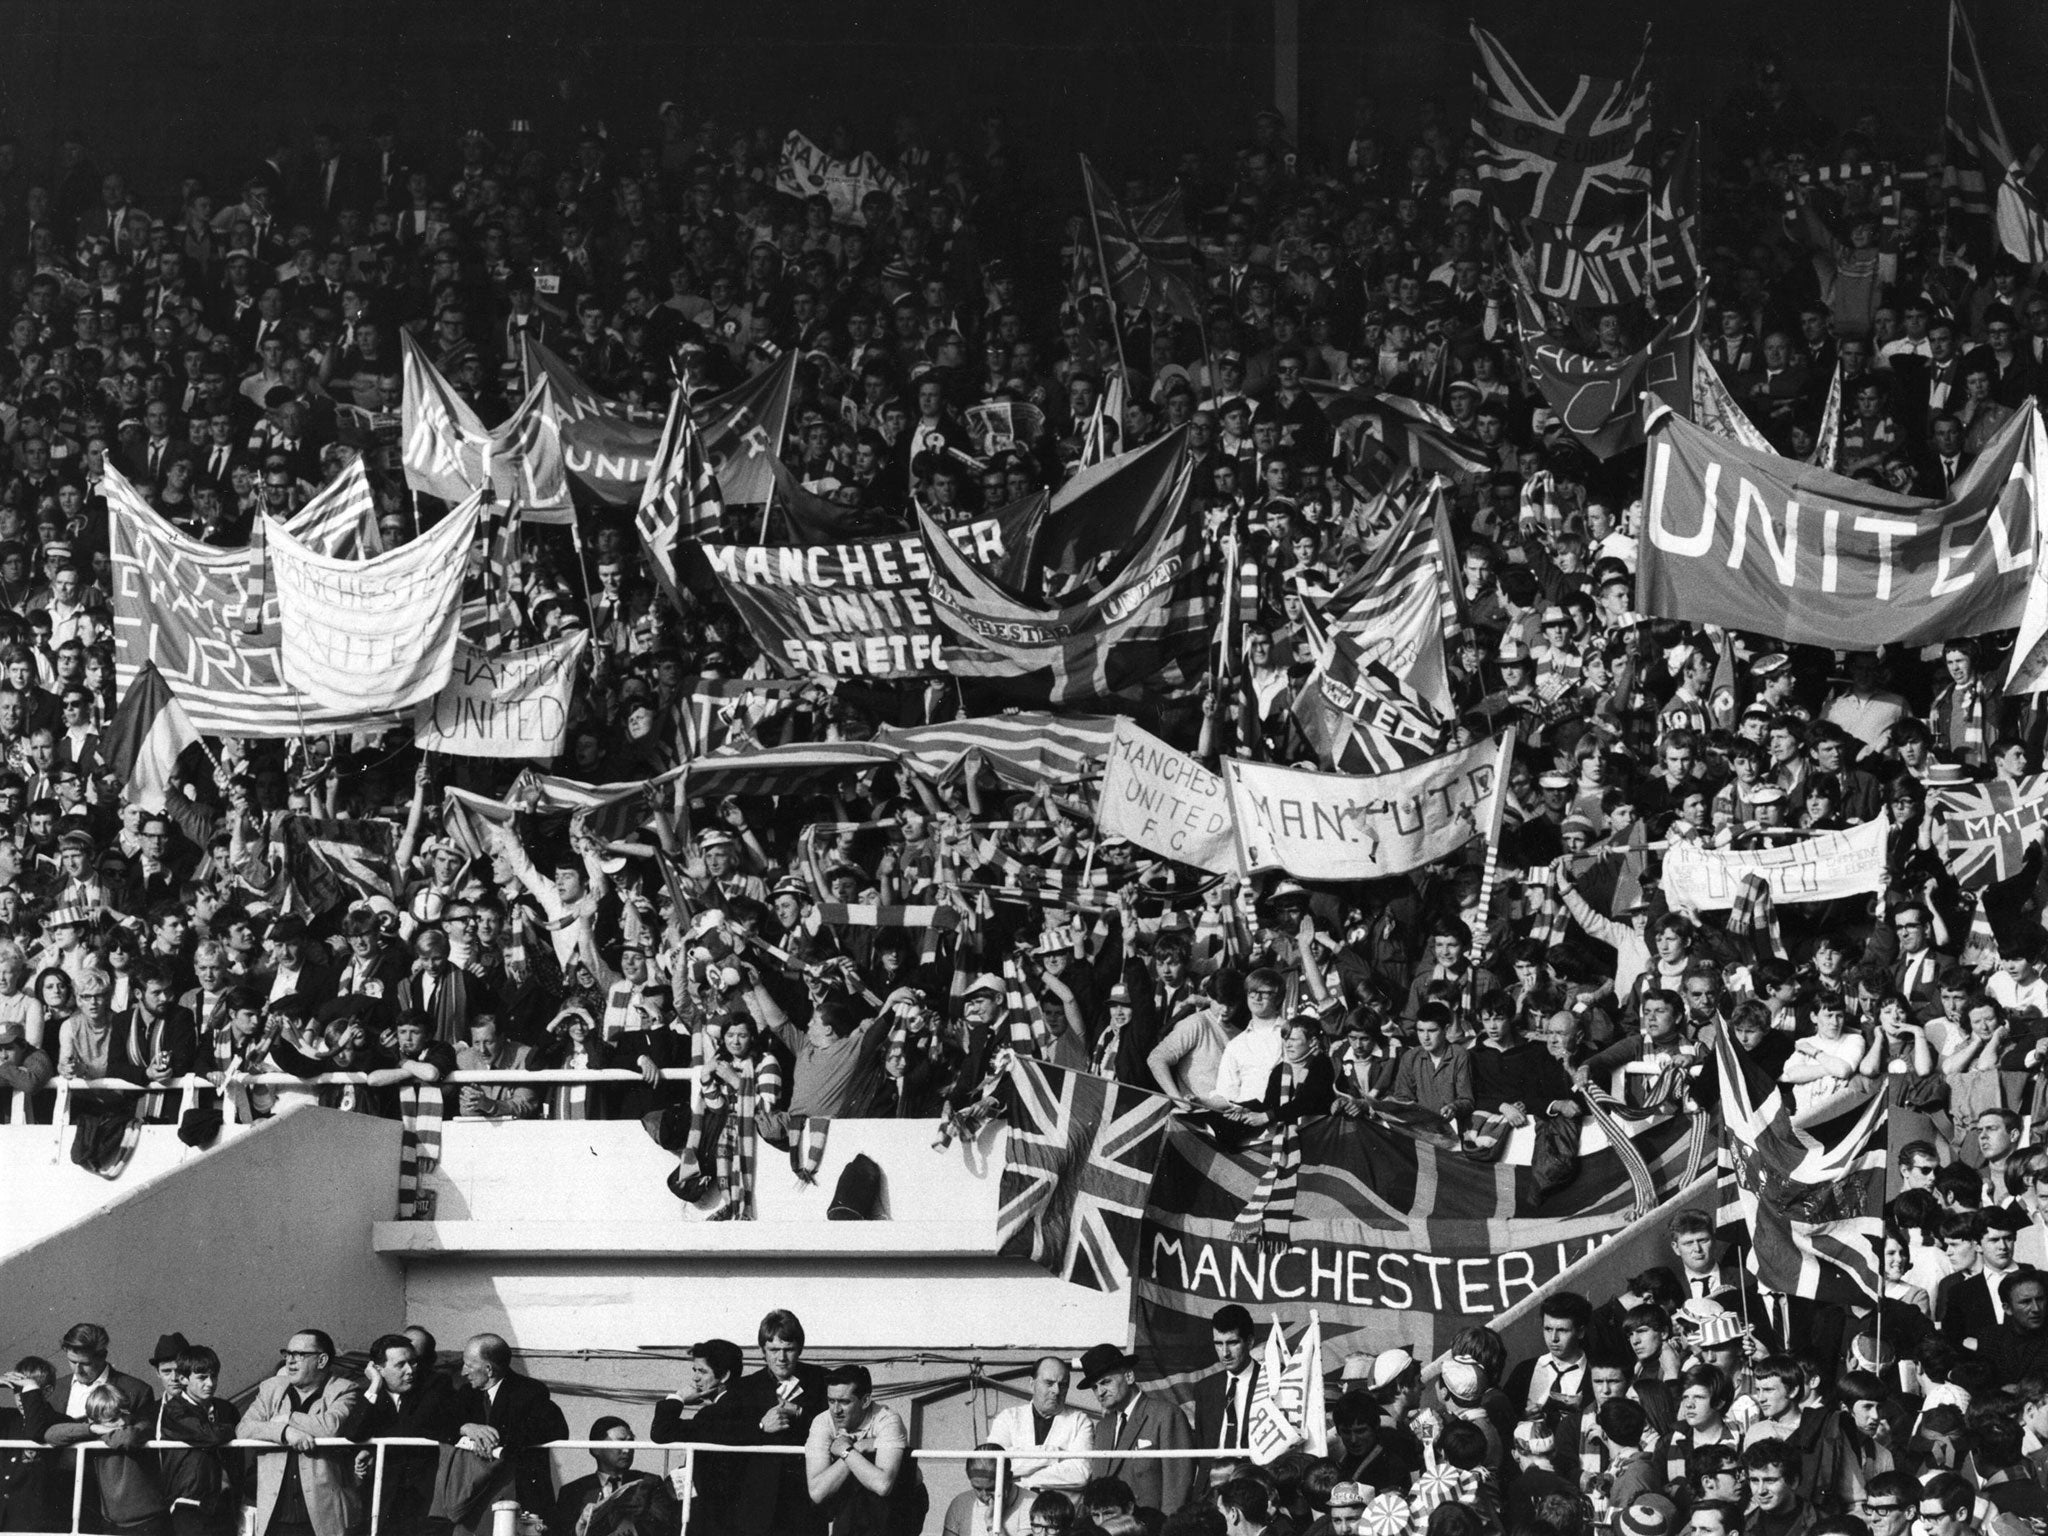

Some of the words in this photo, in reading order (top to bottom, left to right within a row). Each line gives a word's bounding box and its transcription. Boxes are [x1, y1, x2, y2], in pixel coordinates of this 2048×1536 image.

[701, 517, 1006, 589] MANCHESER
[433, 690, 566, 743] UNITED
[1113, 734, 1226, 803] MANCHES
[1125, 778, 1224, 835] UNITED
[1963, 796, 2045, 841] MATT
[1151, 1230, 1541, 1314] MANCHESTER
